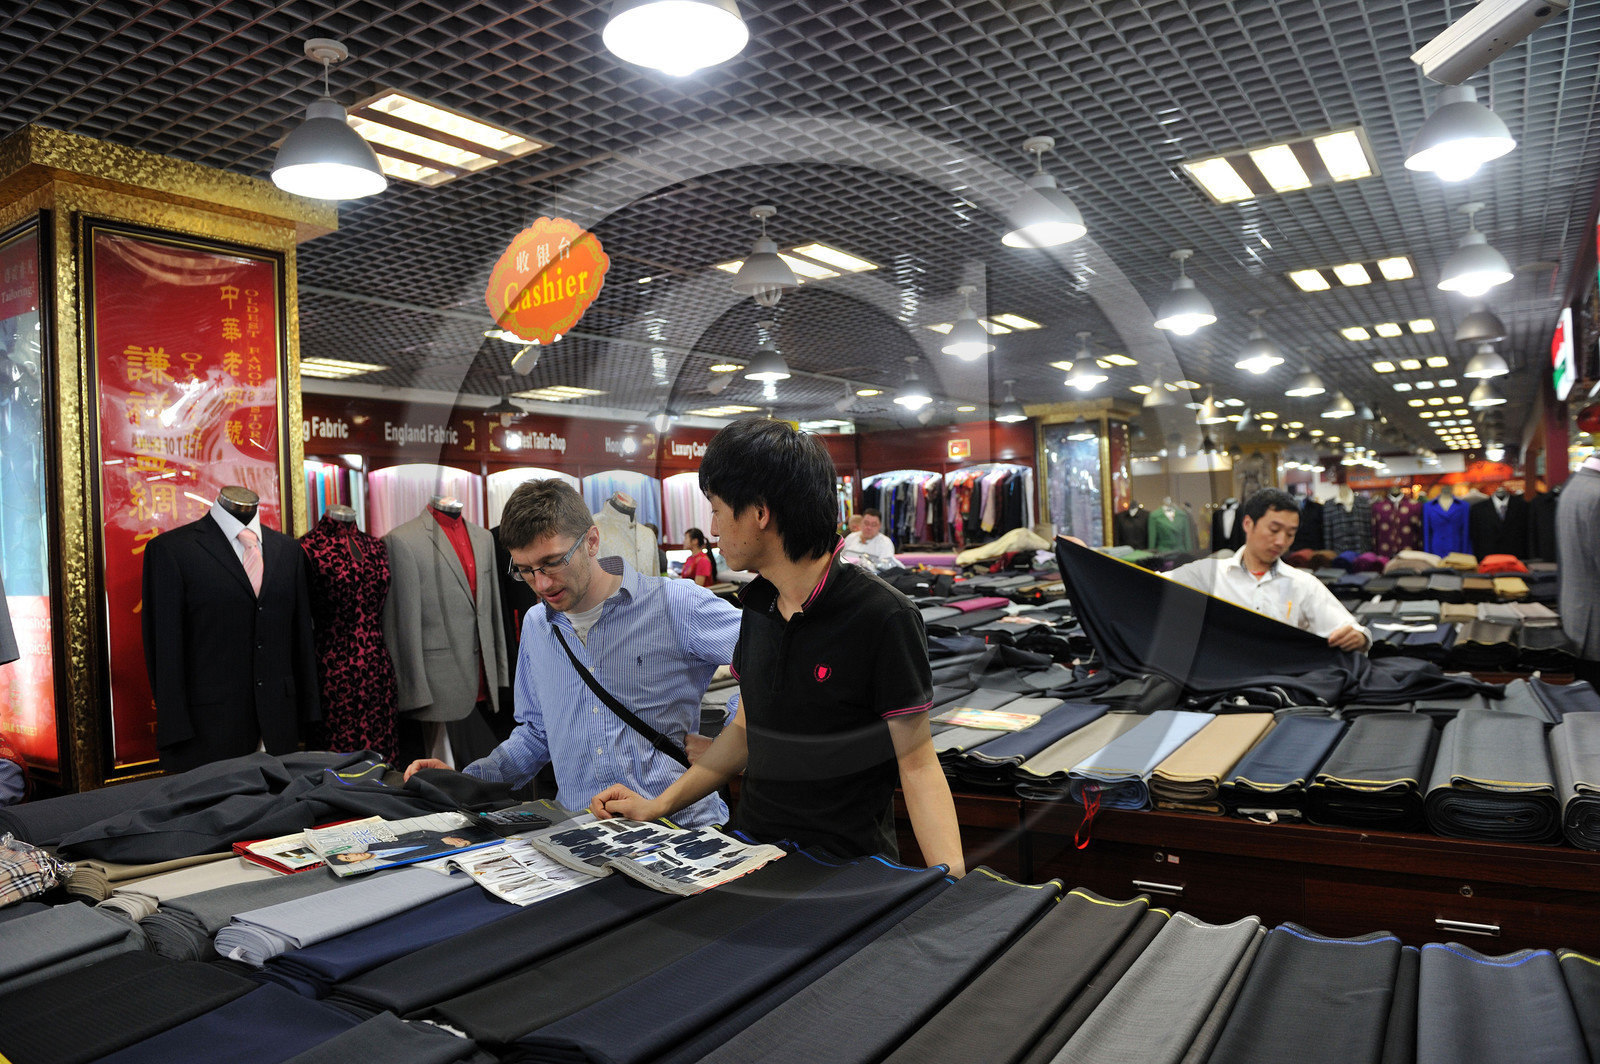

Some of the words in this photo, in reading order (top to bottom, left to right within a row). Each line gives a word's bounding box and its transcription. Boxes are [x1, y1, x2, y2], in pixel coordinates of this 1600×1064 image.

[515, 236, 571, 274] 收银台
[503, 267, 588, 314] Cashier
[311, 415, 349, 439] Fabric
[384, 421, 427, 446] England
[427, 424, 459, 444] Fabric
[532, 431, 550, 450] Tailor
[550, 433, 566, 455] Shop
[671, 440, 693, 460] Luxury
